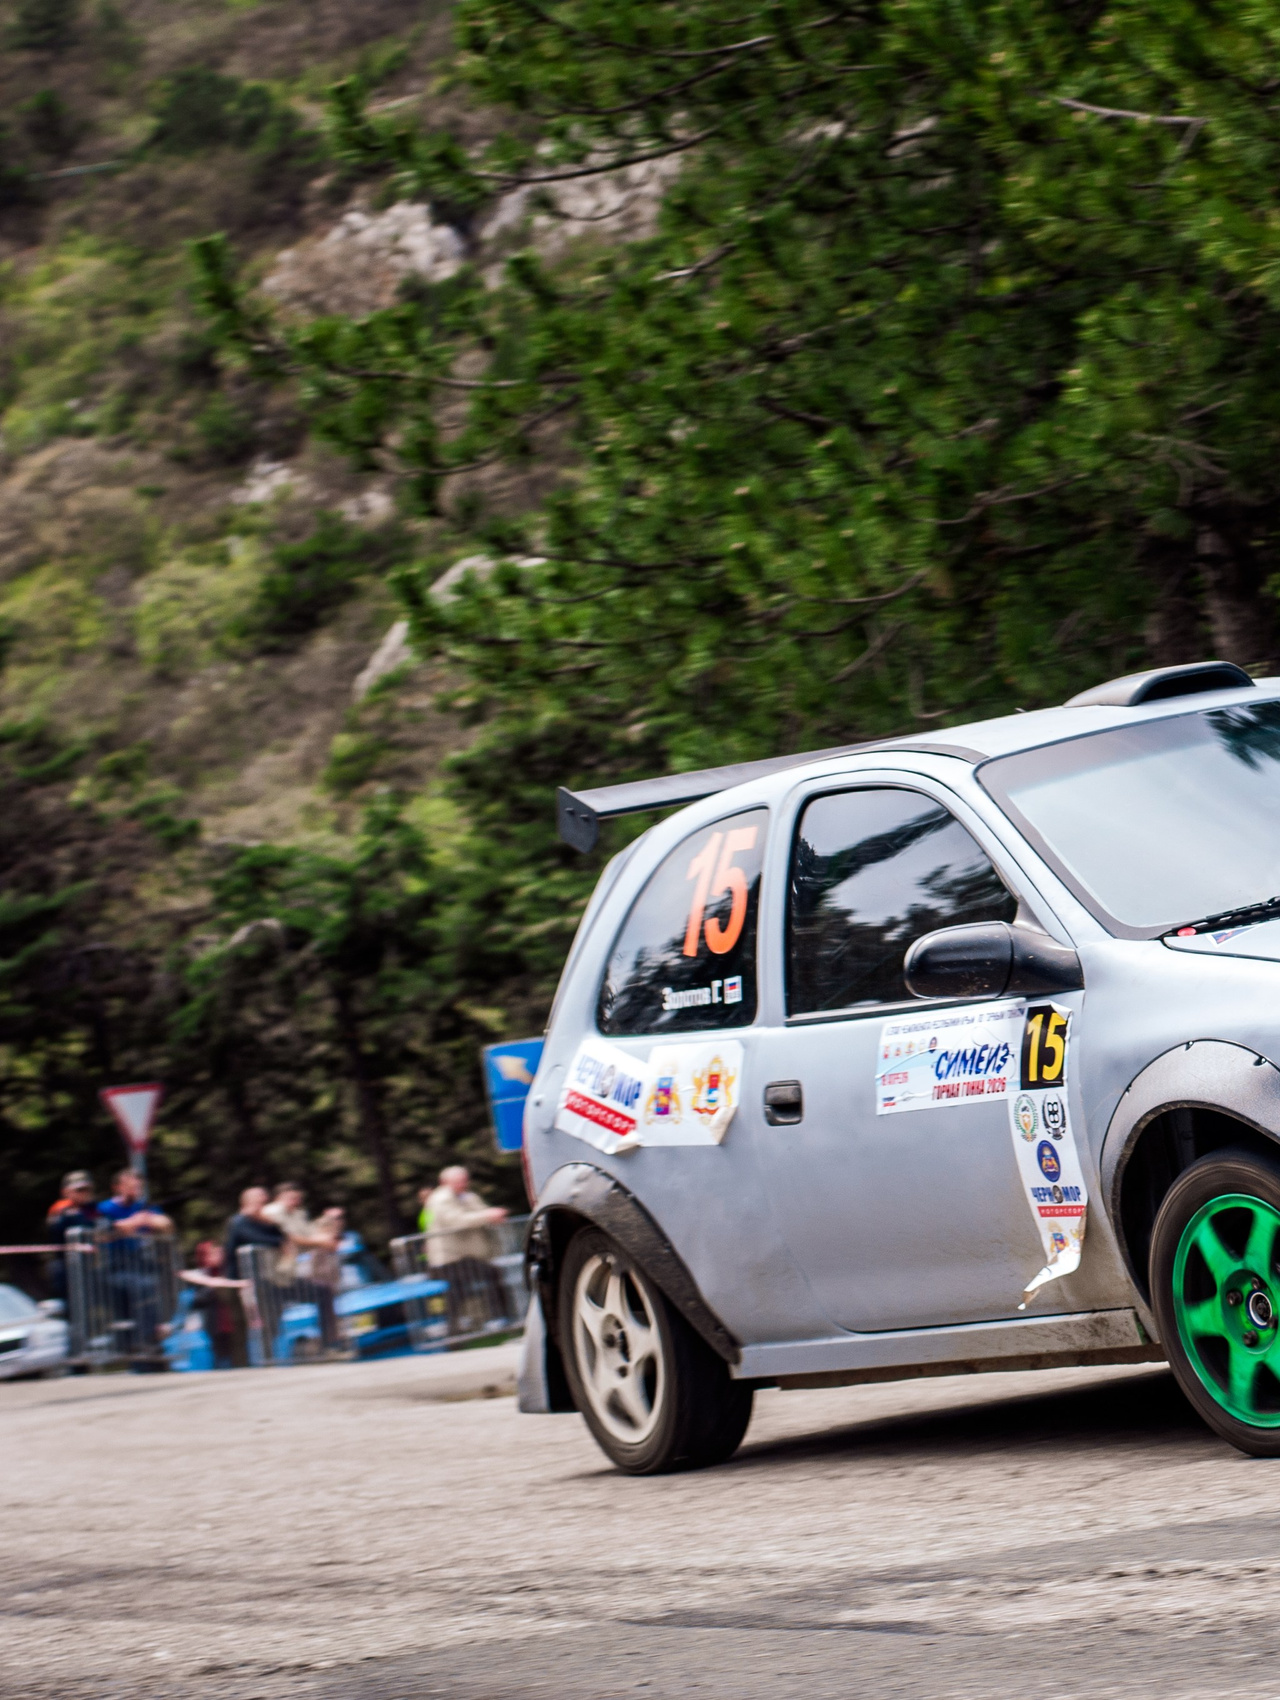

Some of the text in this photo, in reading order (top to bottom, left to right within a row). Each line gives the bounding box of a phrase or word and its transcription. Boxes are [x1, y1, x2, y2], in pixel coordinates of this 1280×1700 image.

[682, 826, 758, 957] 15
[935, 1043, 1010, 1081] СИМЕИЗ
[1026, 1012, 1067, 1082] 15
[931, 1077, 1007, 1101] ГОРНАЯ ГОНКА 2026
